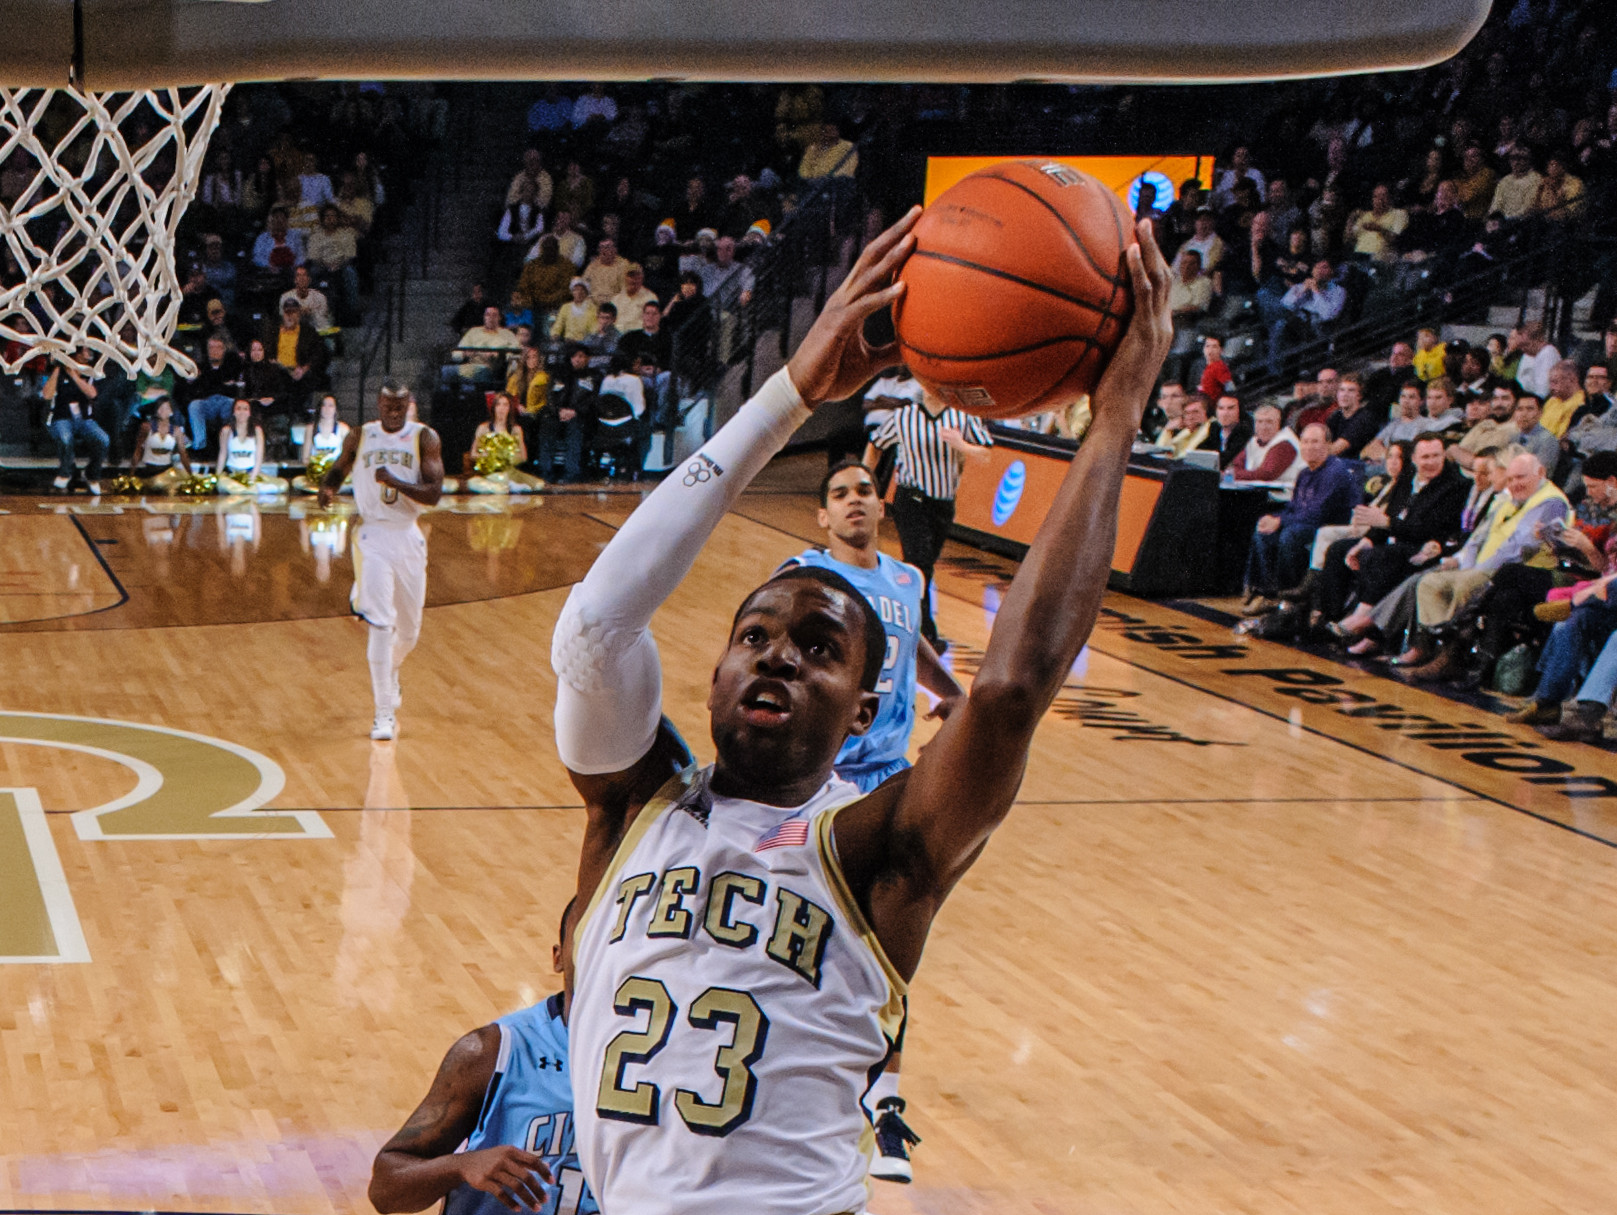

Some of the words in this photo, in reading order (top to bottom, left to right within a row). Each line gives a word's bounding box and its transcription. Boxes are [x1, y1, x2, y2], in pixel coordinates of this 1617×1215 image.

[362, 449, 414, 469] TECH
[1221, 667, 1617, 798] Pavilion
[609, 866, 835, 990] TECH
[596, 976, 771, 1138] 23
